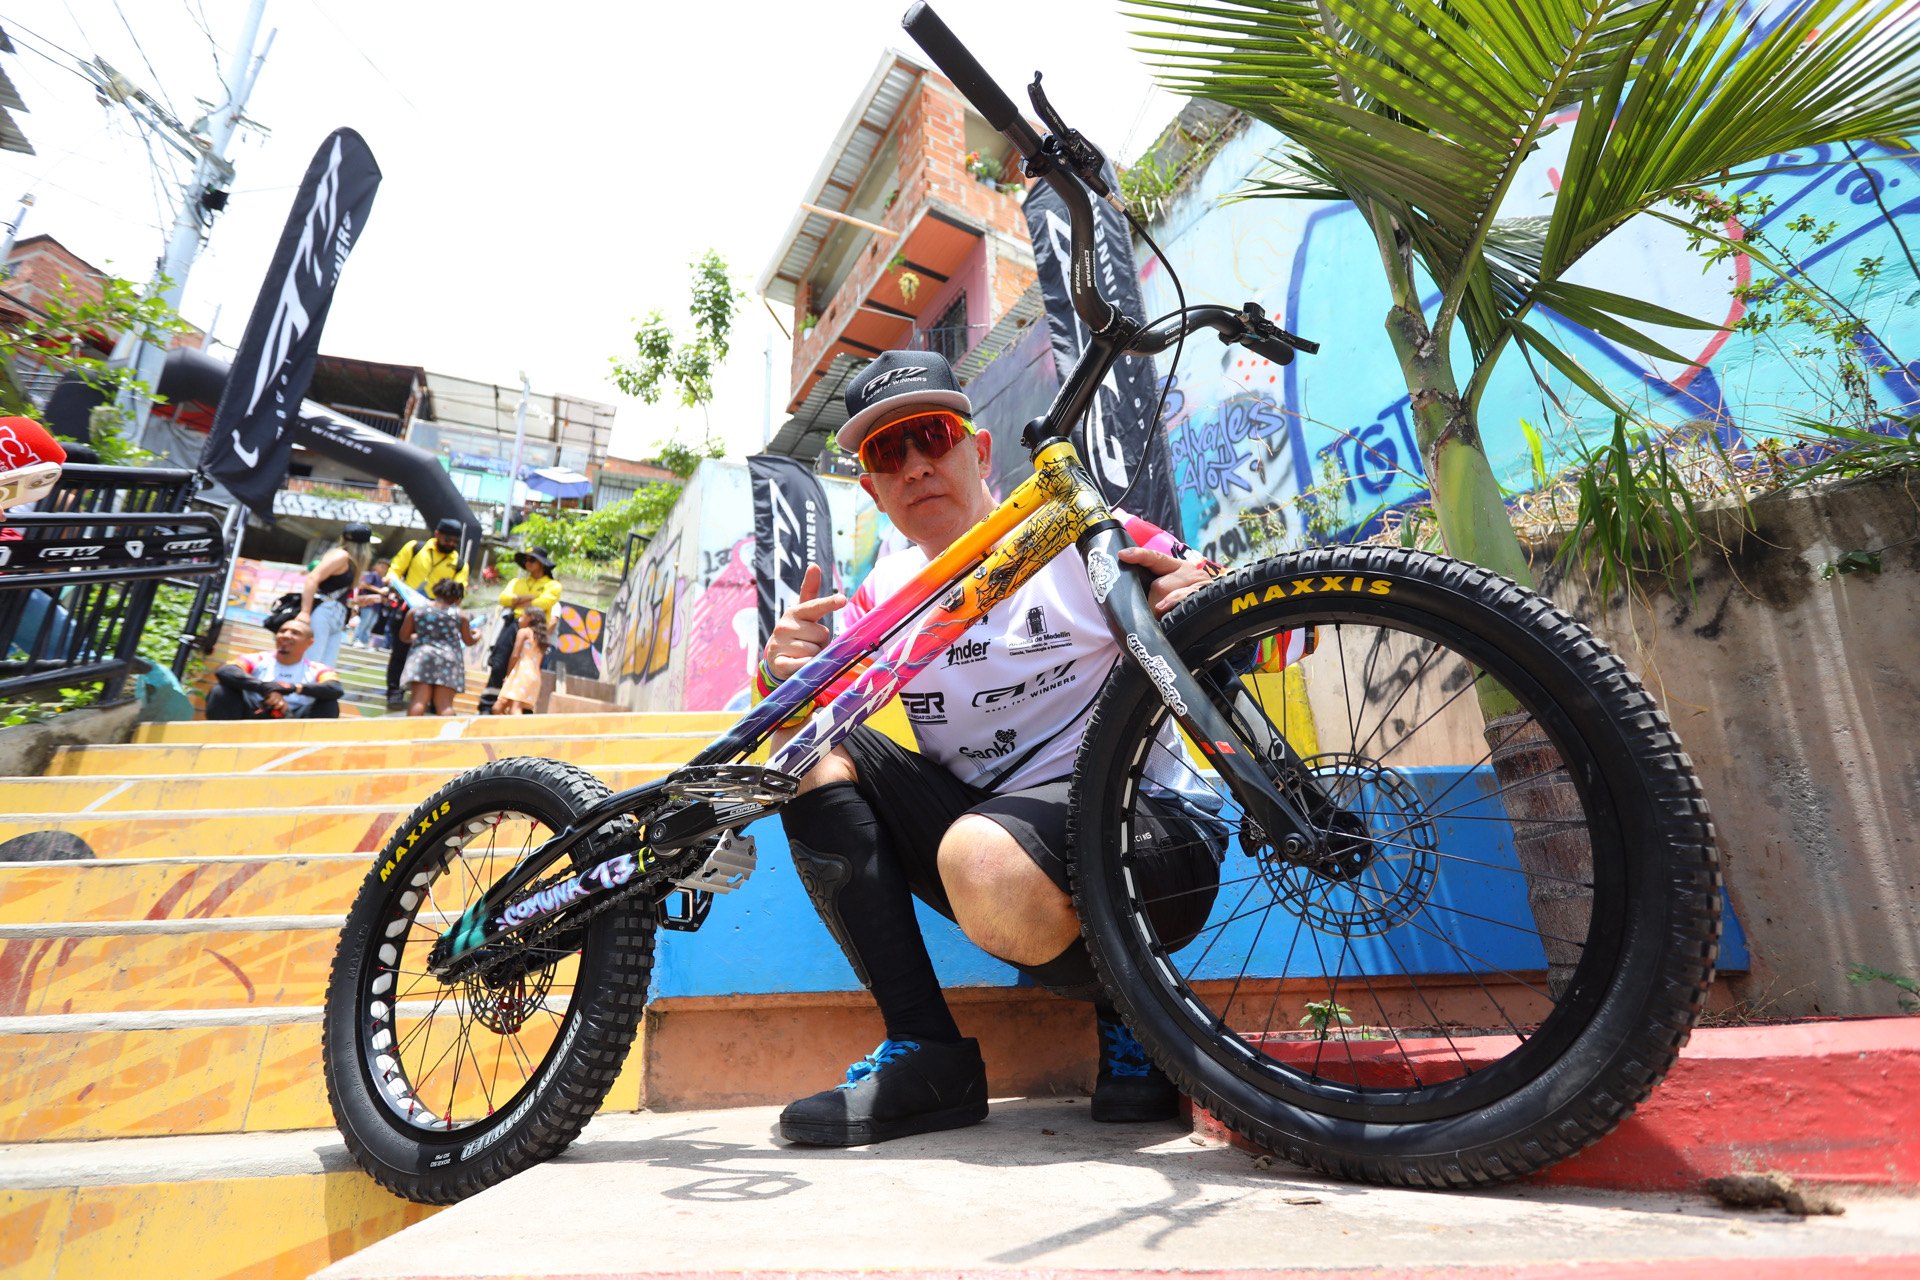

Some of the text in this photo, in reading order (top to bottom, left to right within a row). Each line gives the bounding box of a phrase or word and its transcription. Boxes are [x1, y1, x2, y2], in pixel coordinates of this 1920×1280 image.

[892, 377, 927, 386] WINNERS
[311, 424, 373, 455] WINNERS
[804, 500, 817, 569] INNERS
[1231, 576, 1393, 615] MAXXIS
[1030, 674, 1077, 699] WINNERS
[380, 801, 451, 882] MAXXIS
[1134, 831, 1153, 843] CING
[503, 852, 637, 927] COMUNA 13
